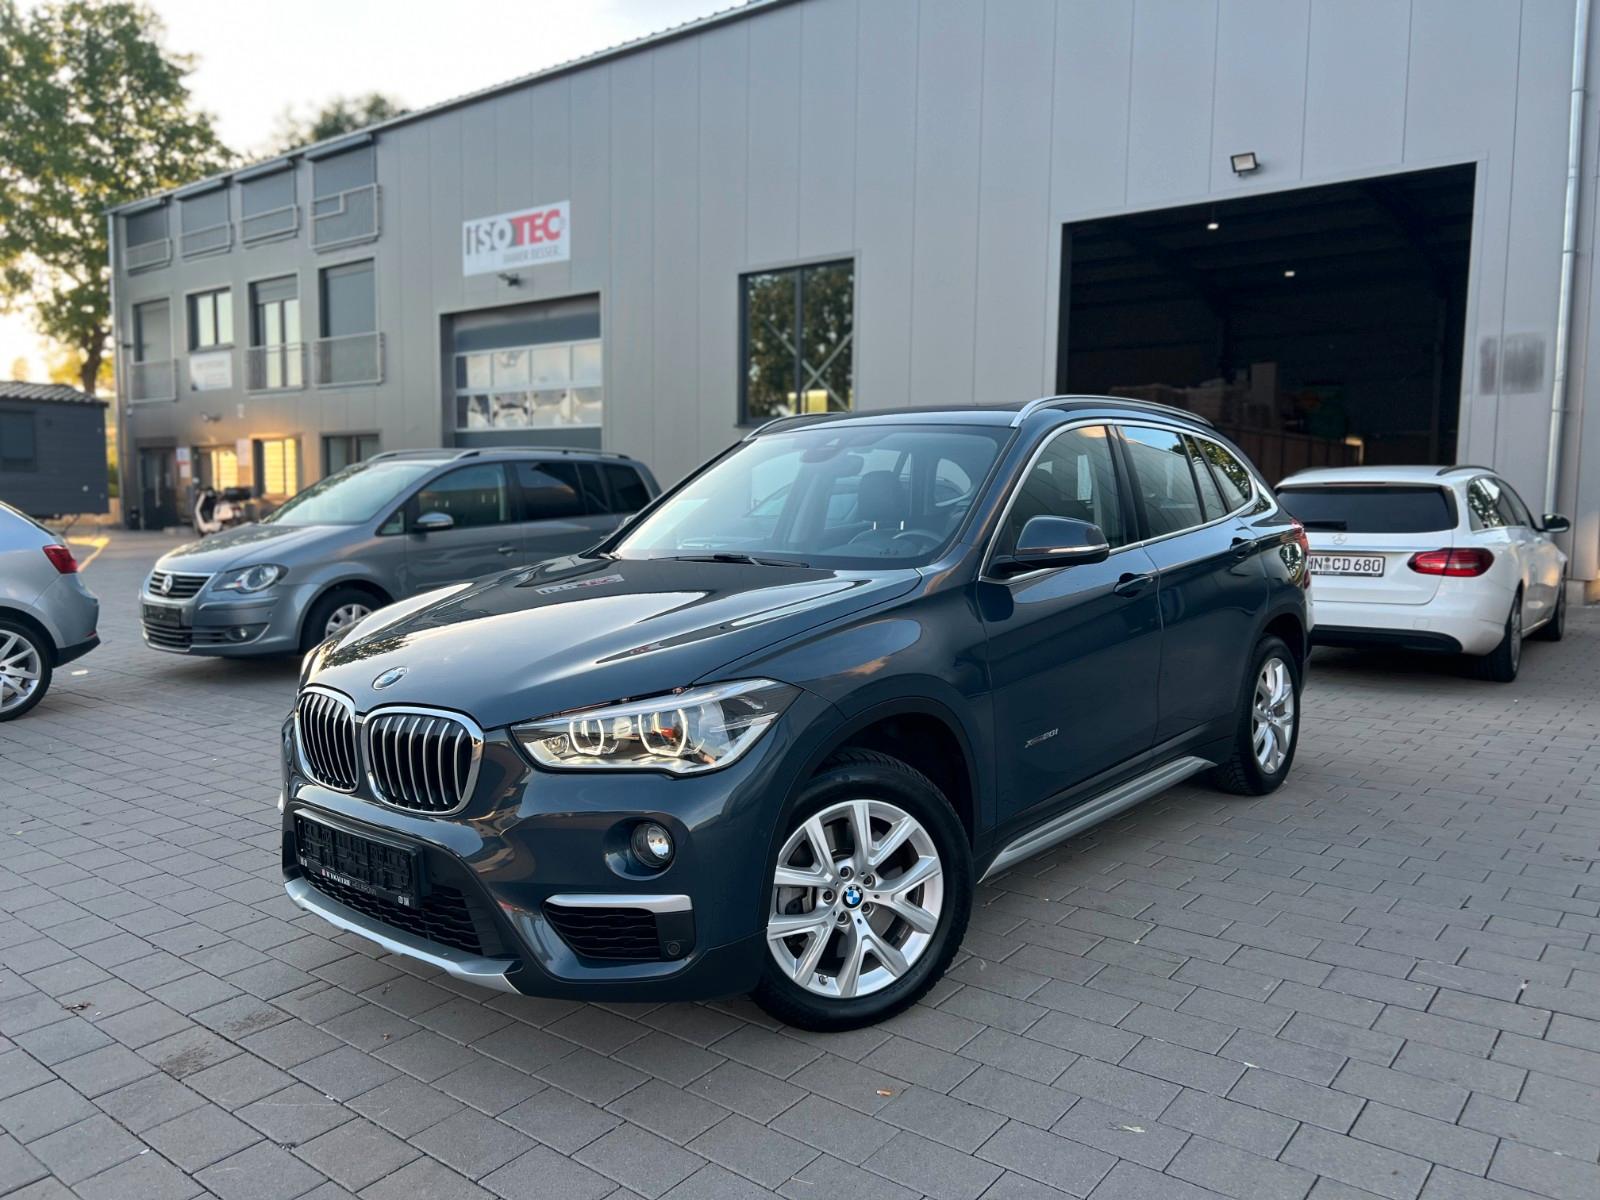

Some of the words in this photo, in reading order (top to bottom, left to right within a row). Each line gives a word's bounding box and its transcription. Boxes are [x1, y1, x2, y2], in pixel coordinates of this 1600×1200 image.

[466, 209, 560, 255] ISOTEC
[1332, 558, 1351, 571] CD
[1353, 559, 1381, 572] 680
